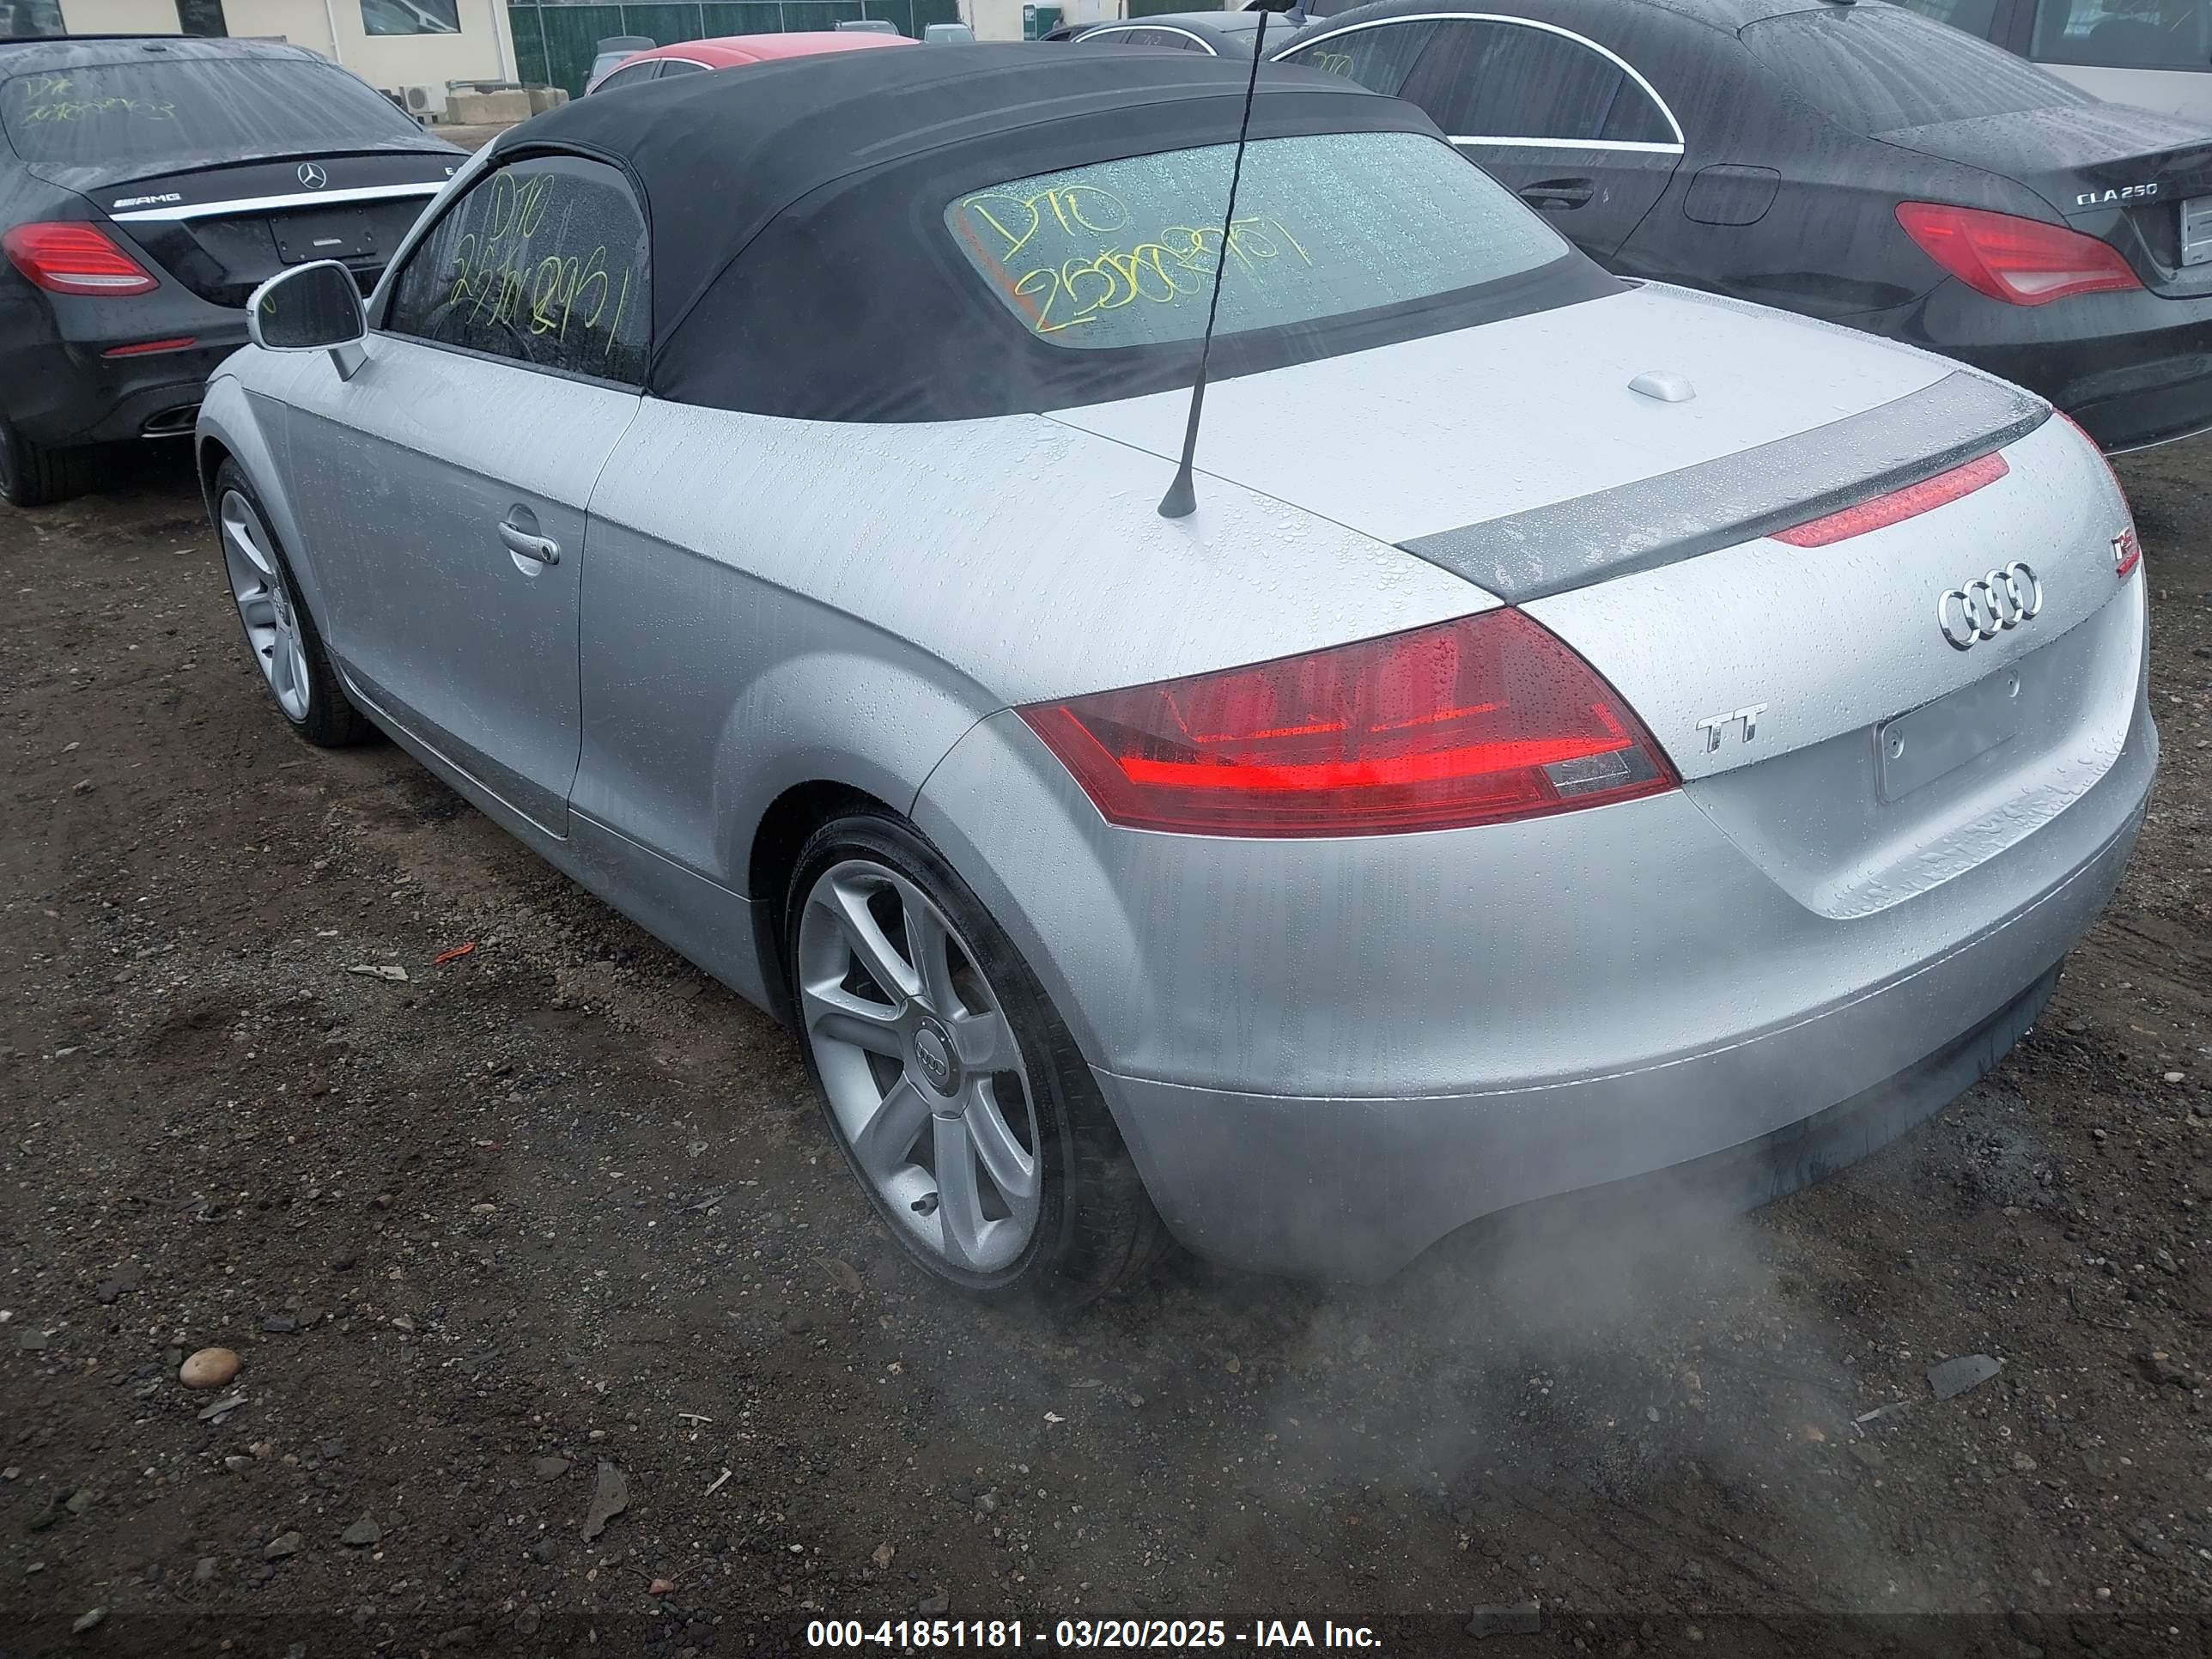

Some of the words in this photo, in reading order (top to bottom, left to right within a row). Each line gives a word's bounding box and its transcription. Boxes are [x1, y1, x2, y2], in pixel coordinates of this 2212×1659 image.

[136, 192, 182, 204] AMG
[2076, 189, 2118, 206] CLA
[2121, 183, 2158, 198] 250
[1696, 702, 1768, 753] TT
